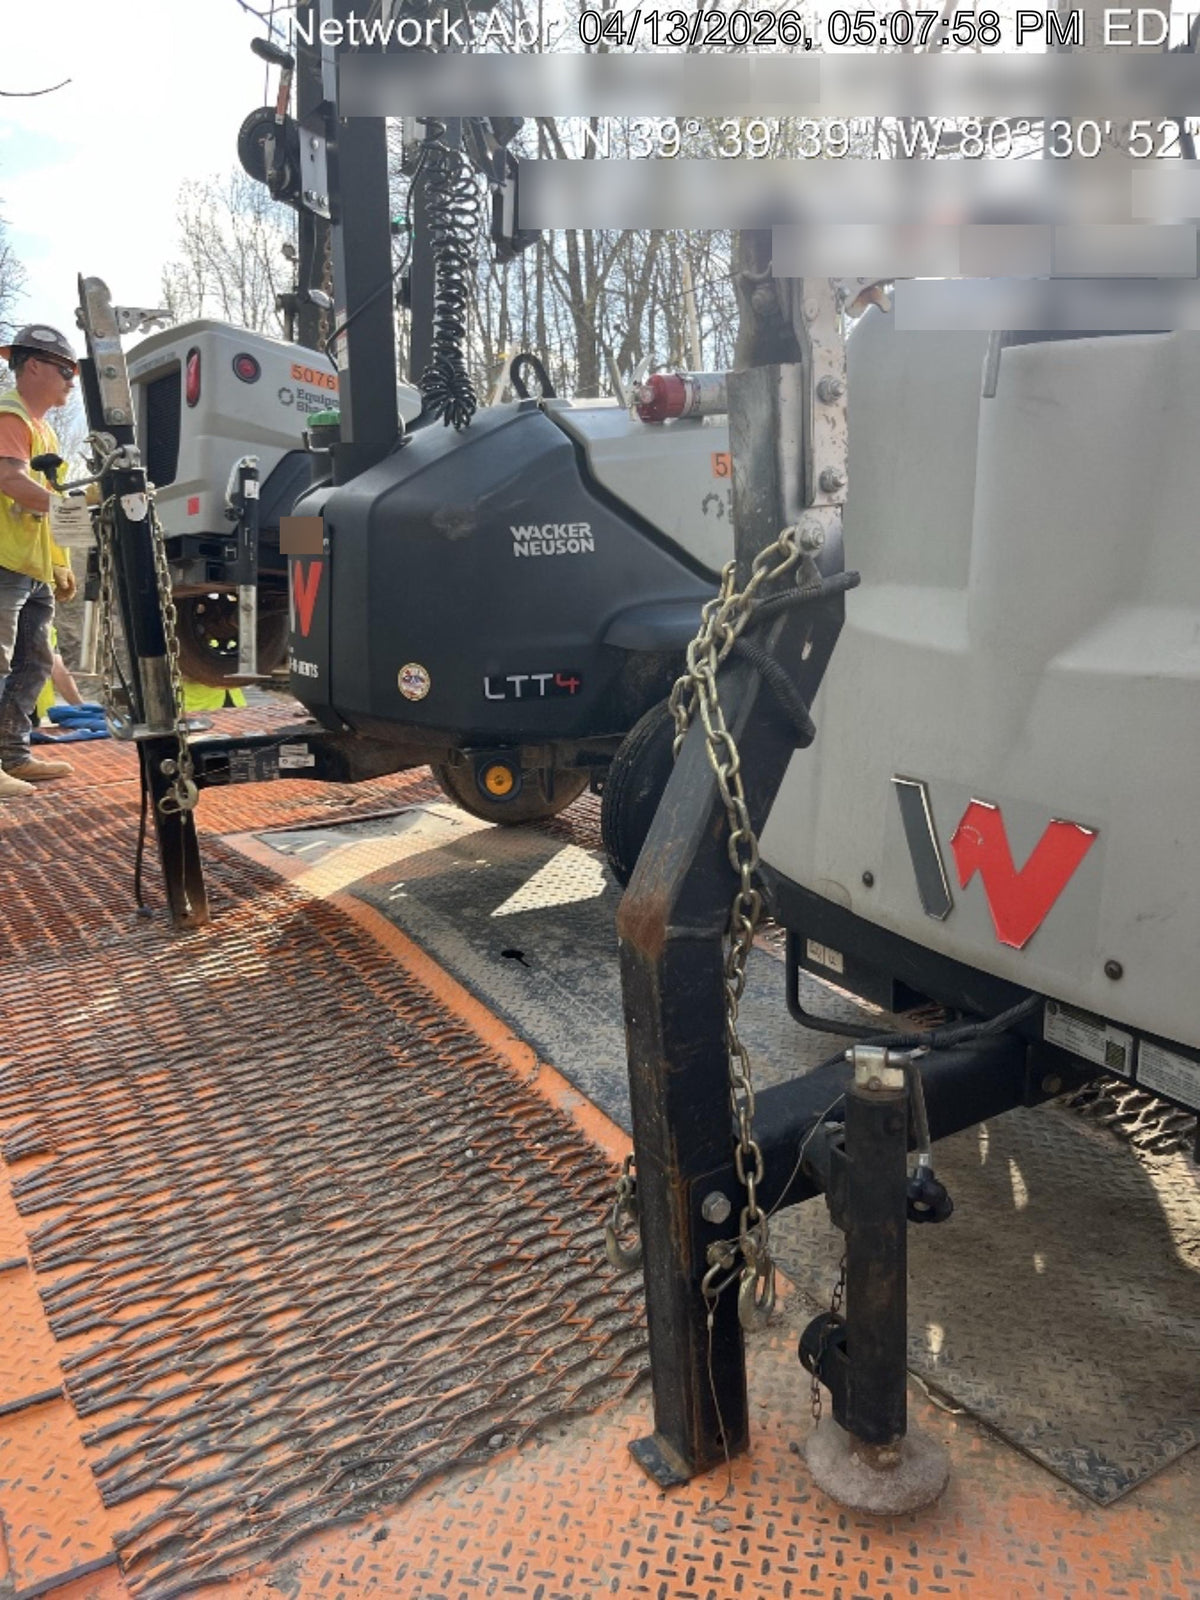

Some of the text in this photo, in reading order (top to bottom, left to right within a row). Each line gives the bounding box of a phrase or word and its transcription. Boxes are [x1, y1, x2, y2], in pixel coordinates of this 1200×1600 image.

[510, 522, 593, 541] WACKER
[513, 538, 595, 557] NEUSON
[483, 673, 580, 699] LTT4
